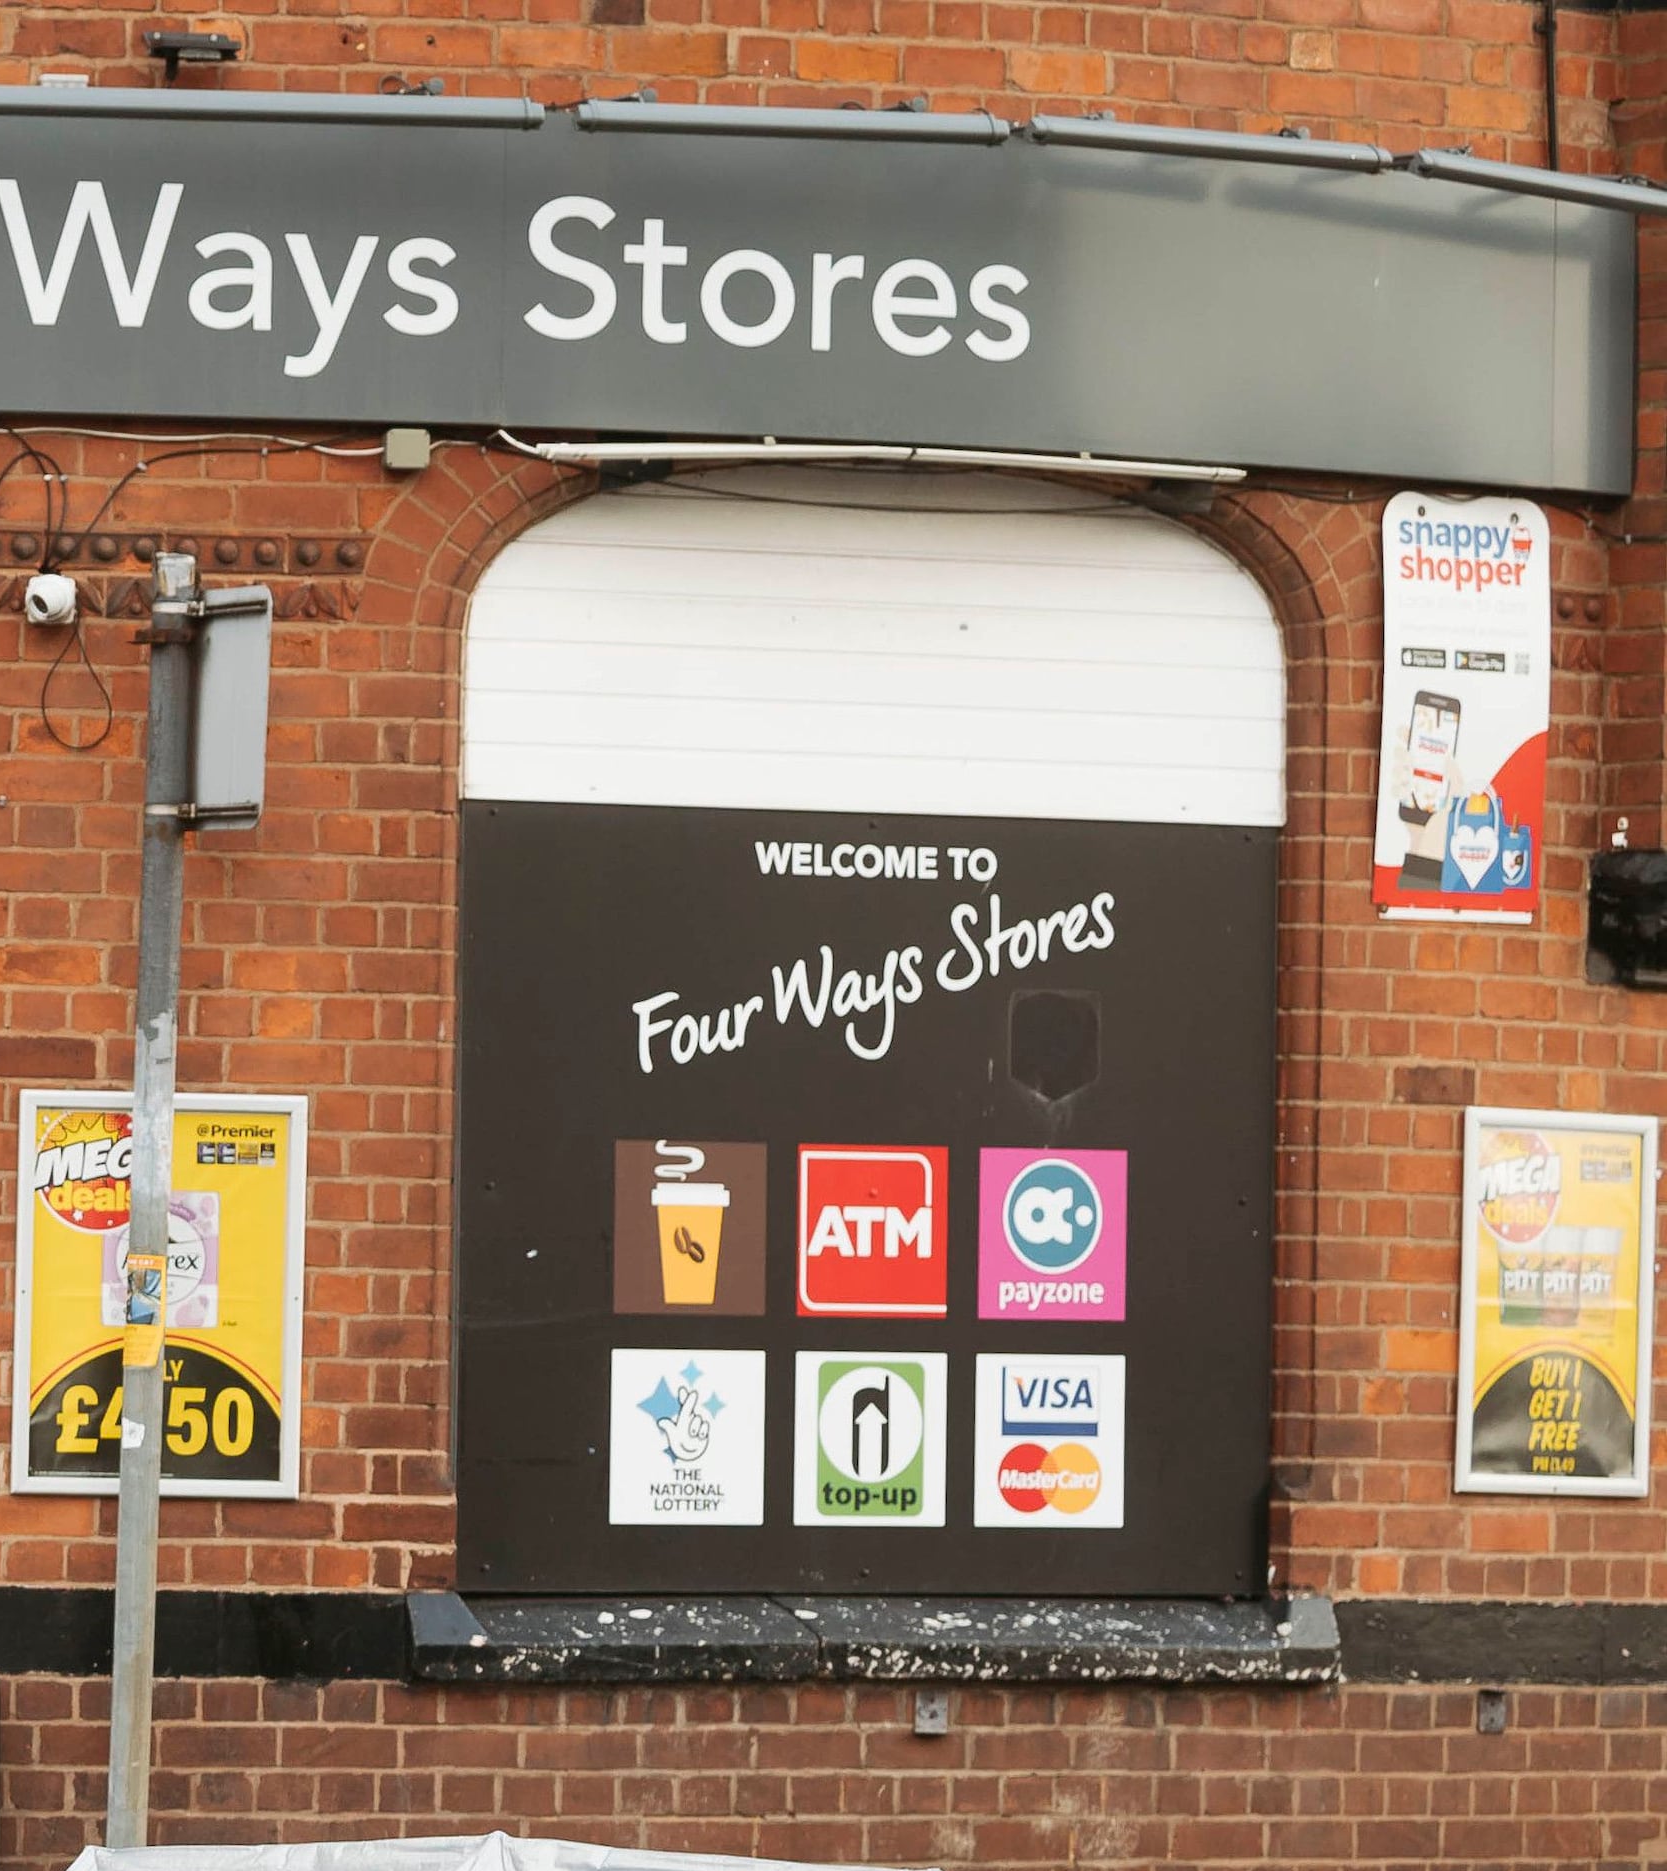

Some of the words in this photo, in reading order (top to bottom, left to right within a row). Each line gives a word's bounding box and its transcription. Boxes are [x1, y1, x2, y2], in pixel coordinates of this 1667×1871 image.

[524, 196, 1030, 361] Stores
[1399, 520, 1510, 559] snappy
[1400, 546, 1526, 592] shopper
[754, 841, 938, 880] WELCOME
[947, 847, 998, 882] TO
[632, 991, 764, 1074] Four
[772, 944, 923, 1060] Ways
[936, 891, 1116, 992] Stores
[34, 1133, 132, 1192] MEG
[1478, 1153, 1560, 1204] MEGA
[49, 1179, 131, 1212] deal
[1485, 1195, 1548, 1225] deals
[807, 1205, 933, 1260] ATM
[998, 1281, 1104, 1311] payzone
[163, 1359, 184, 1381] LY
[1530, 1357, 1570, 1388] BUY
[1015, 1376, 1094, 1410] VISA
[1529, 1388, 1570, 1420] GET
[1529, 1420, 1581, 1452] FREE
[650, 1483, 725, 1496] NATIONAL
[673, 1468, 702, 1481] THE
[999, 1467, 1099, 1491] MasterCard
[654, 1498, 720, 1511] LOTTERY
[822, 1482, 918, 1510] top-up
